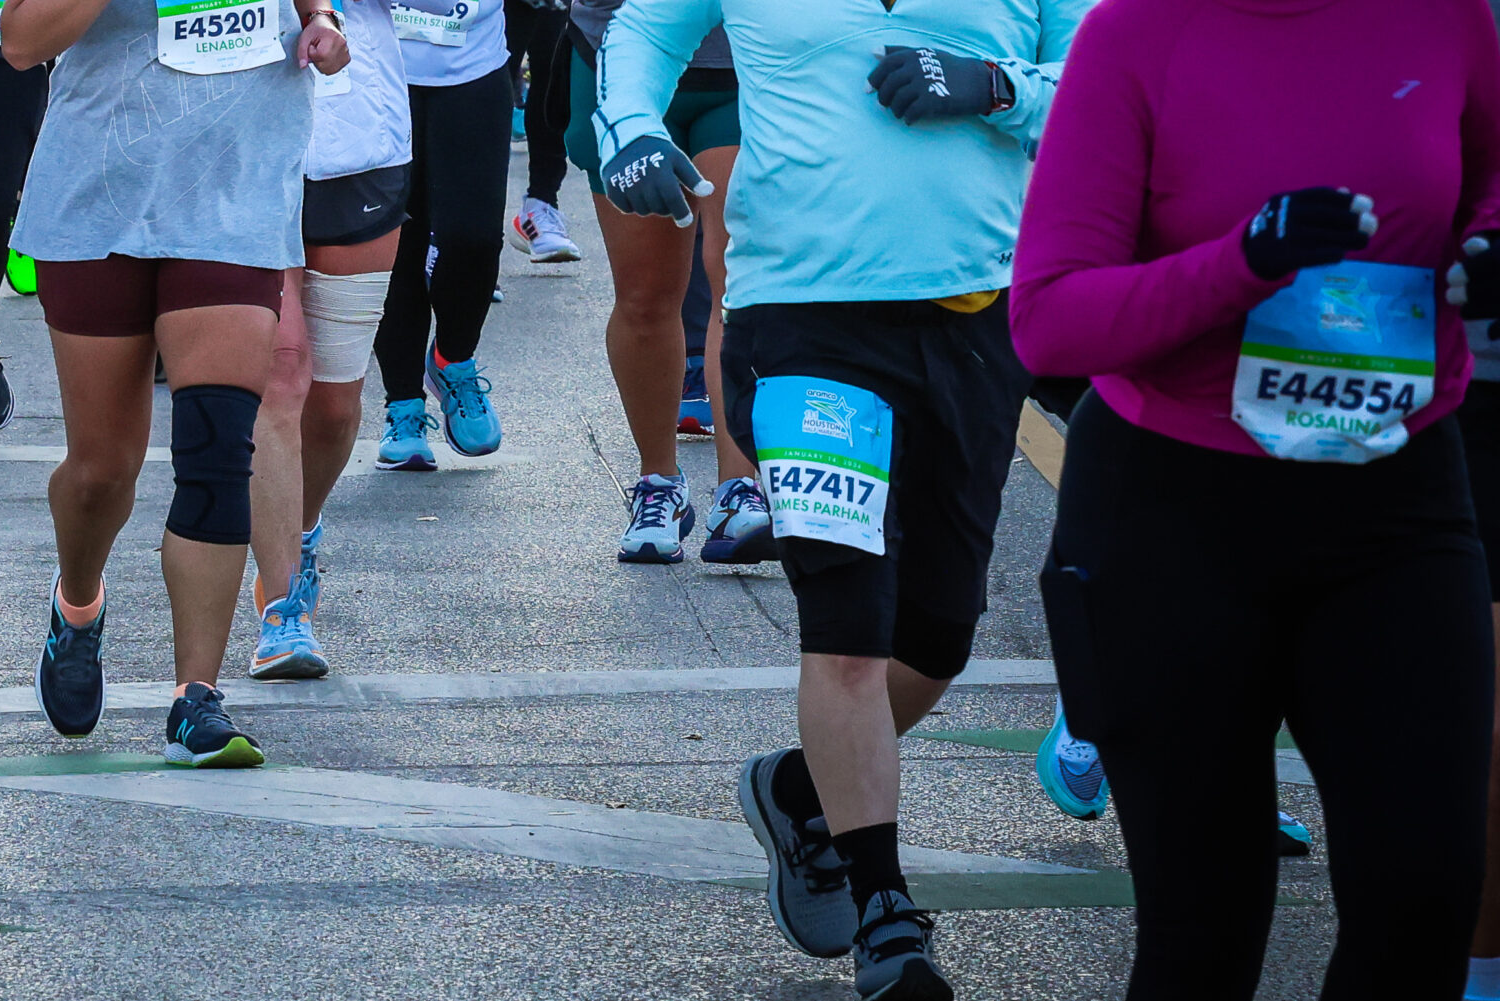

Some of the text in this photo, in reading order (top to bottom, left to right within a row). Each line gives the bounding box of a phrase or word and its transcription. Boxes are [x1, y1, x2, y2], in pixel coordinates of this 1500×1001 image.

[174, 7, 265, 41] E45201
[392, 13, 427, 26] RISTEN
[610, 155, 649, 187] FLEET
[618, 166, 647, 193] FEET
[807, 390, 837, 400] aramco
[1257, 367, 1415, 416] E44554
[803, 419, 842, 431] HOUSTON
[1286, 410, 1382, 436] ROSALINA
[784, 451, 823, 460] JANUARY
[769, 466, 876, 506] E47417
[813, 501, 871, 526] PARHAM
